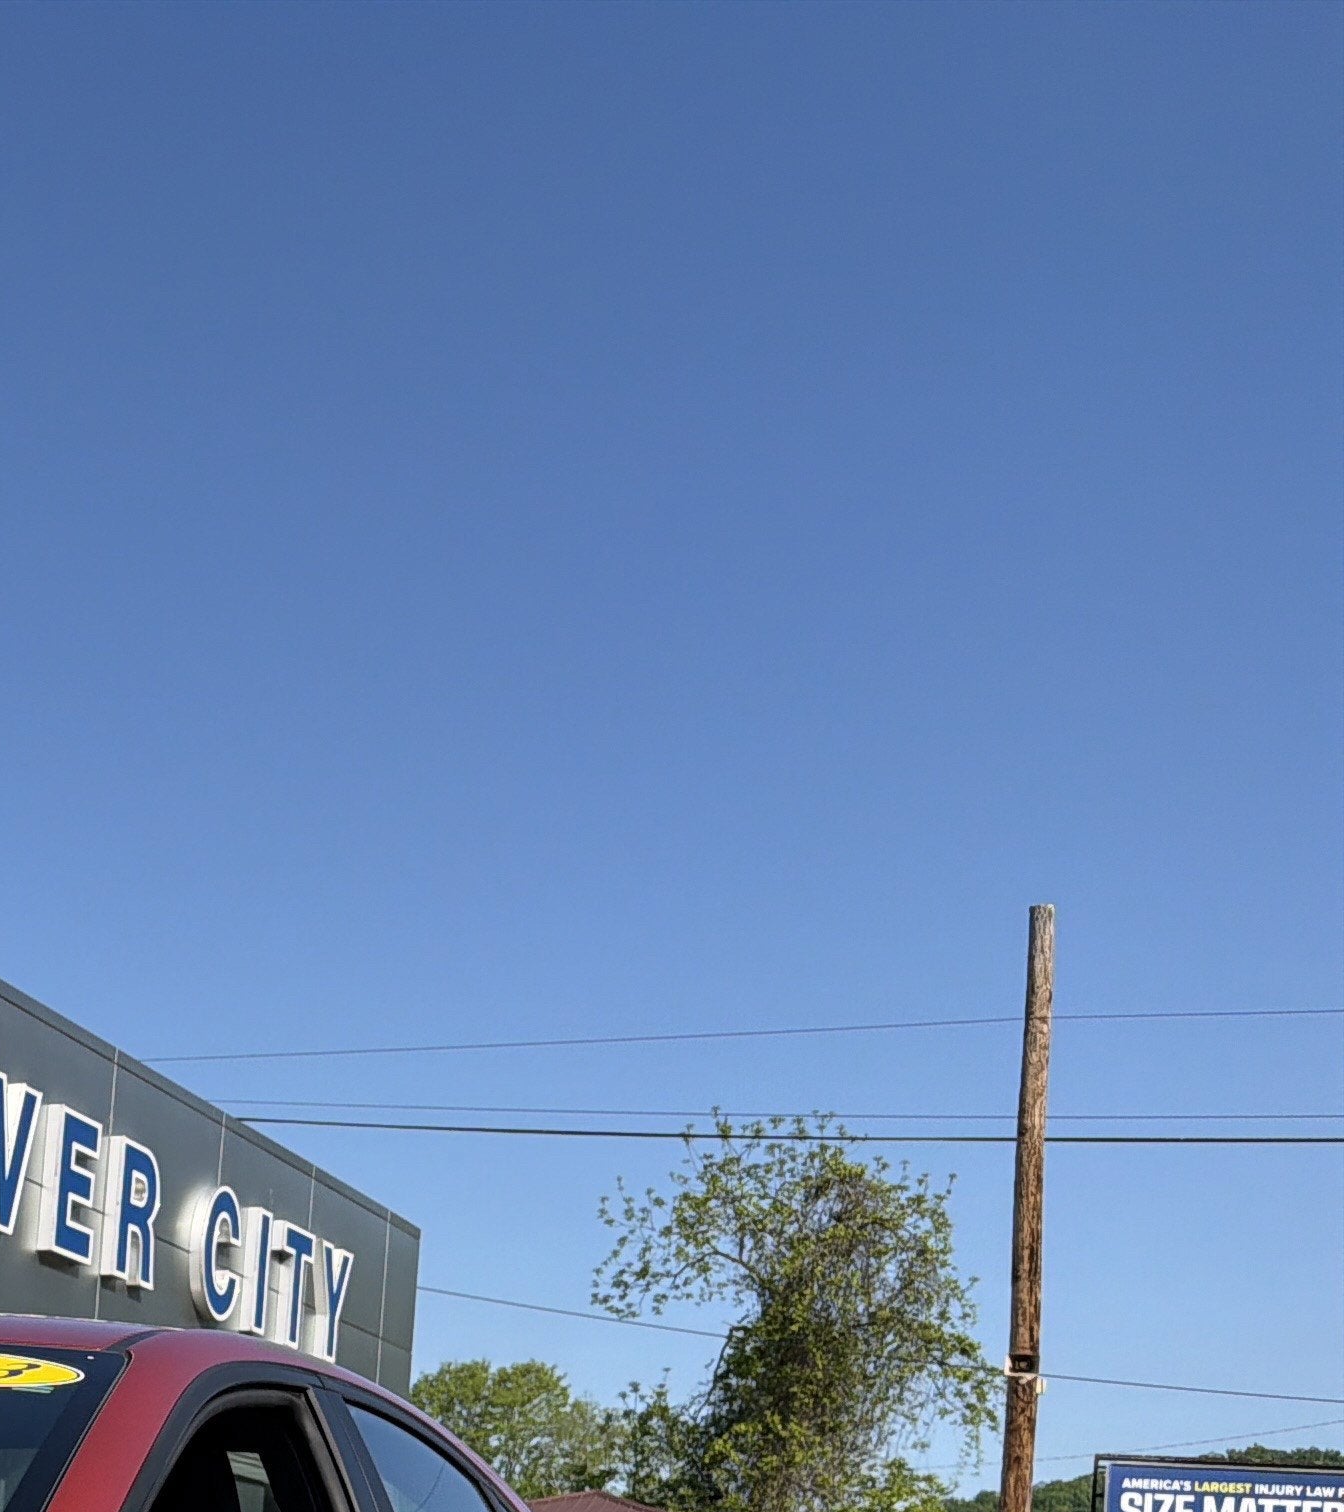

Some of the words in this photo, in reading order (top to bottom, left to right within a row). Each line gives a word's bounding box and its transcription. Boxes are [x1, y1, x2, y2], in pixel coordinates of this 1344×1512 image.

[191, 1186, 355, 1364] CITY
[1122, 1478, 1192, 1491] AMERICA'S
[1194, 1481, 1252, 1494] LARGEST
[1254, 1484, 1304, 1496] INJURY
[1306, 1485, 1335, 1498] LAW
